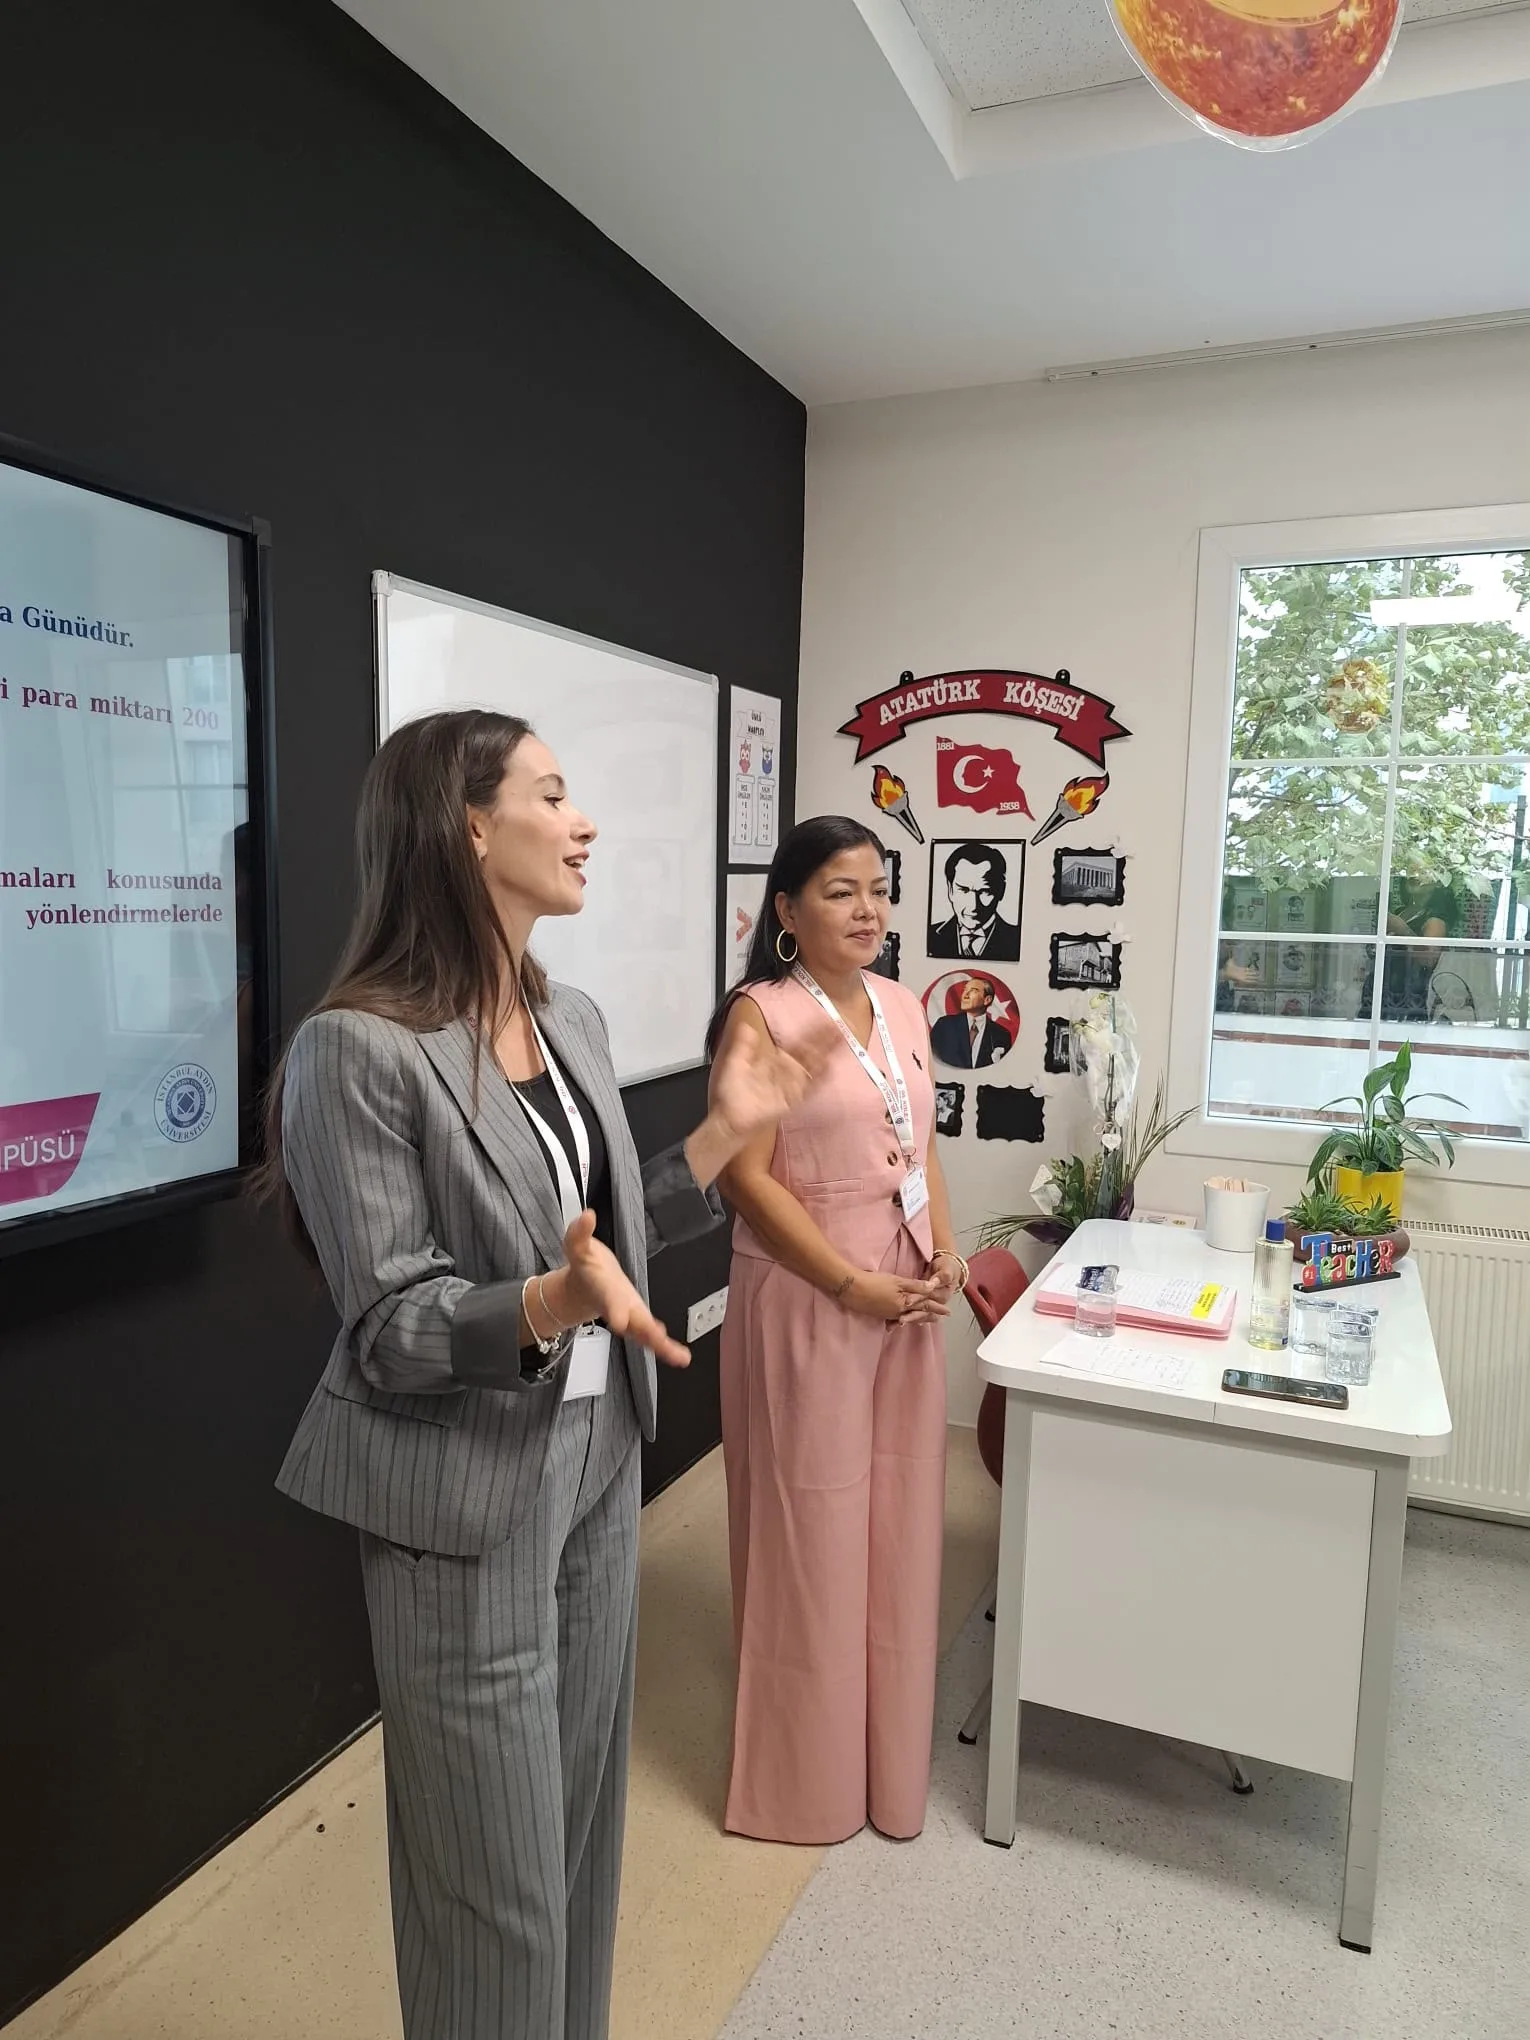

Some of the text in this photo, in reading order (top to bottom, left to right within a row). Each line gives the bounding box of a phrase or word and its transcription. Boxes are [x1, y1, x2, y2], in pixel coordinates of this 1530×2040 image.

[22, 606, 134, 648] Günüdür.
[21, 685, 78, 708] para
[90, 696, 172, 723] miktarı
[182, 706, 219, 730] 200
[880, 678, 1085, 726] ATATÜRK KÖŞESİ
[936, 742, 955, 751] 1881
[1000, 801, 1020, 811] 1938
[107, 869, 223, 890] konusunda
[25, 903, 223, 930] yönlendirmelerde
[0, 1129, 75, 1171] PÜSÜ
[1331, 1243, 1351, 1254] Best
